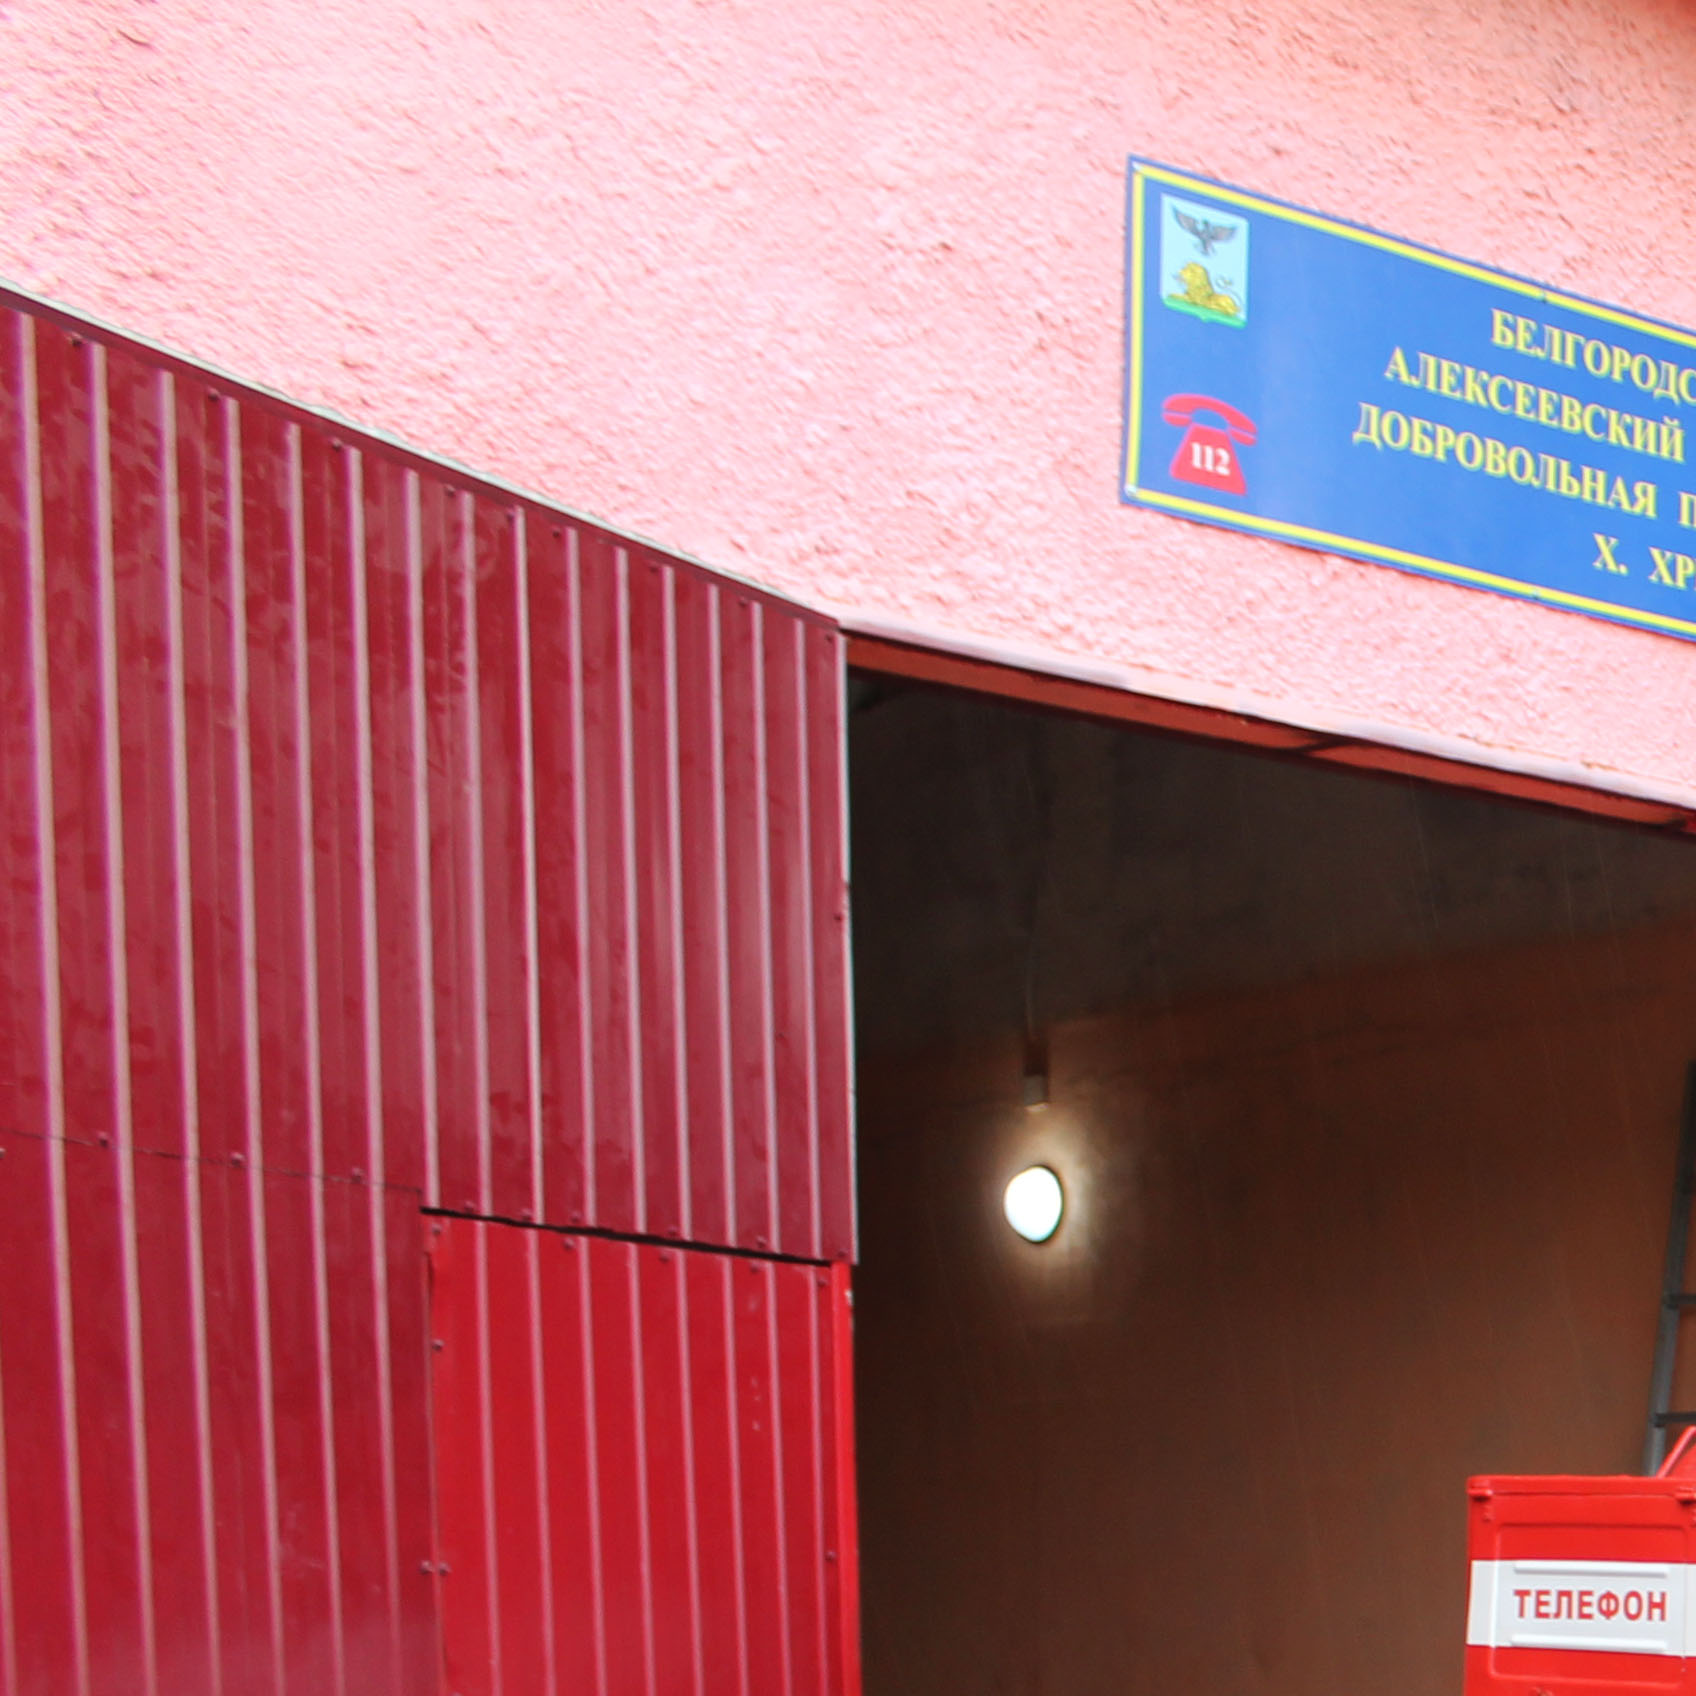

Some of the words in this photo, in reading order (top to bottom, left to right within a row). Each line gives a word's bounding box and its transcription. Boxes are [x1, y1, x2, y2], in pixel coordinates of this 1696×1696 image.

[1384, 346, 1685, 463] АЛЕКСЕЕВСКИЙ
[1191, 442, 1231, 476] 112
[1352, 402, 1657, 519] ДОБРОВОЛЬНАЯ
[1592, 533, 1628, 576] Х.
[1514, 1589, 1668, 1622] ТЕЛЕФОН
